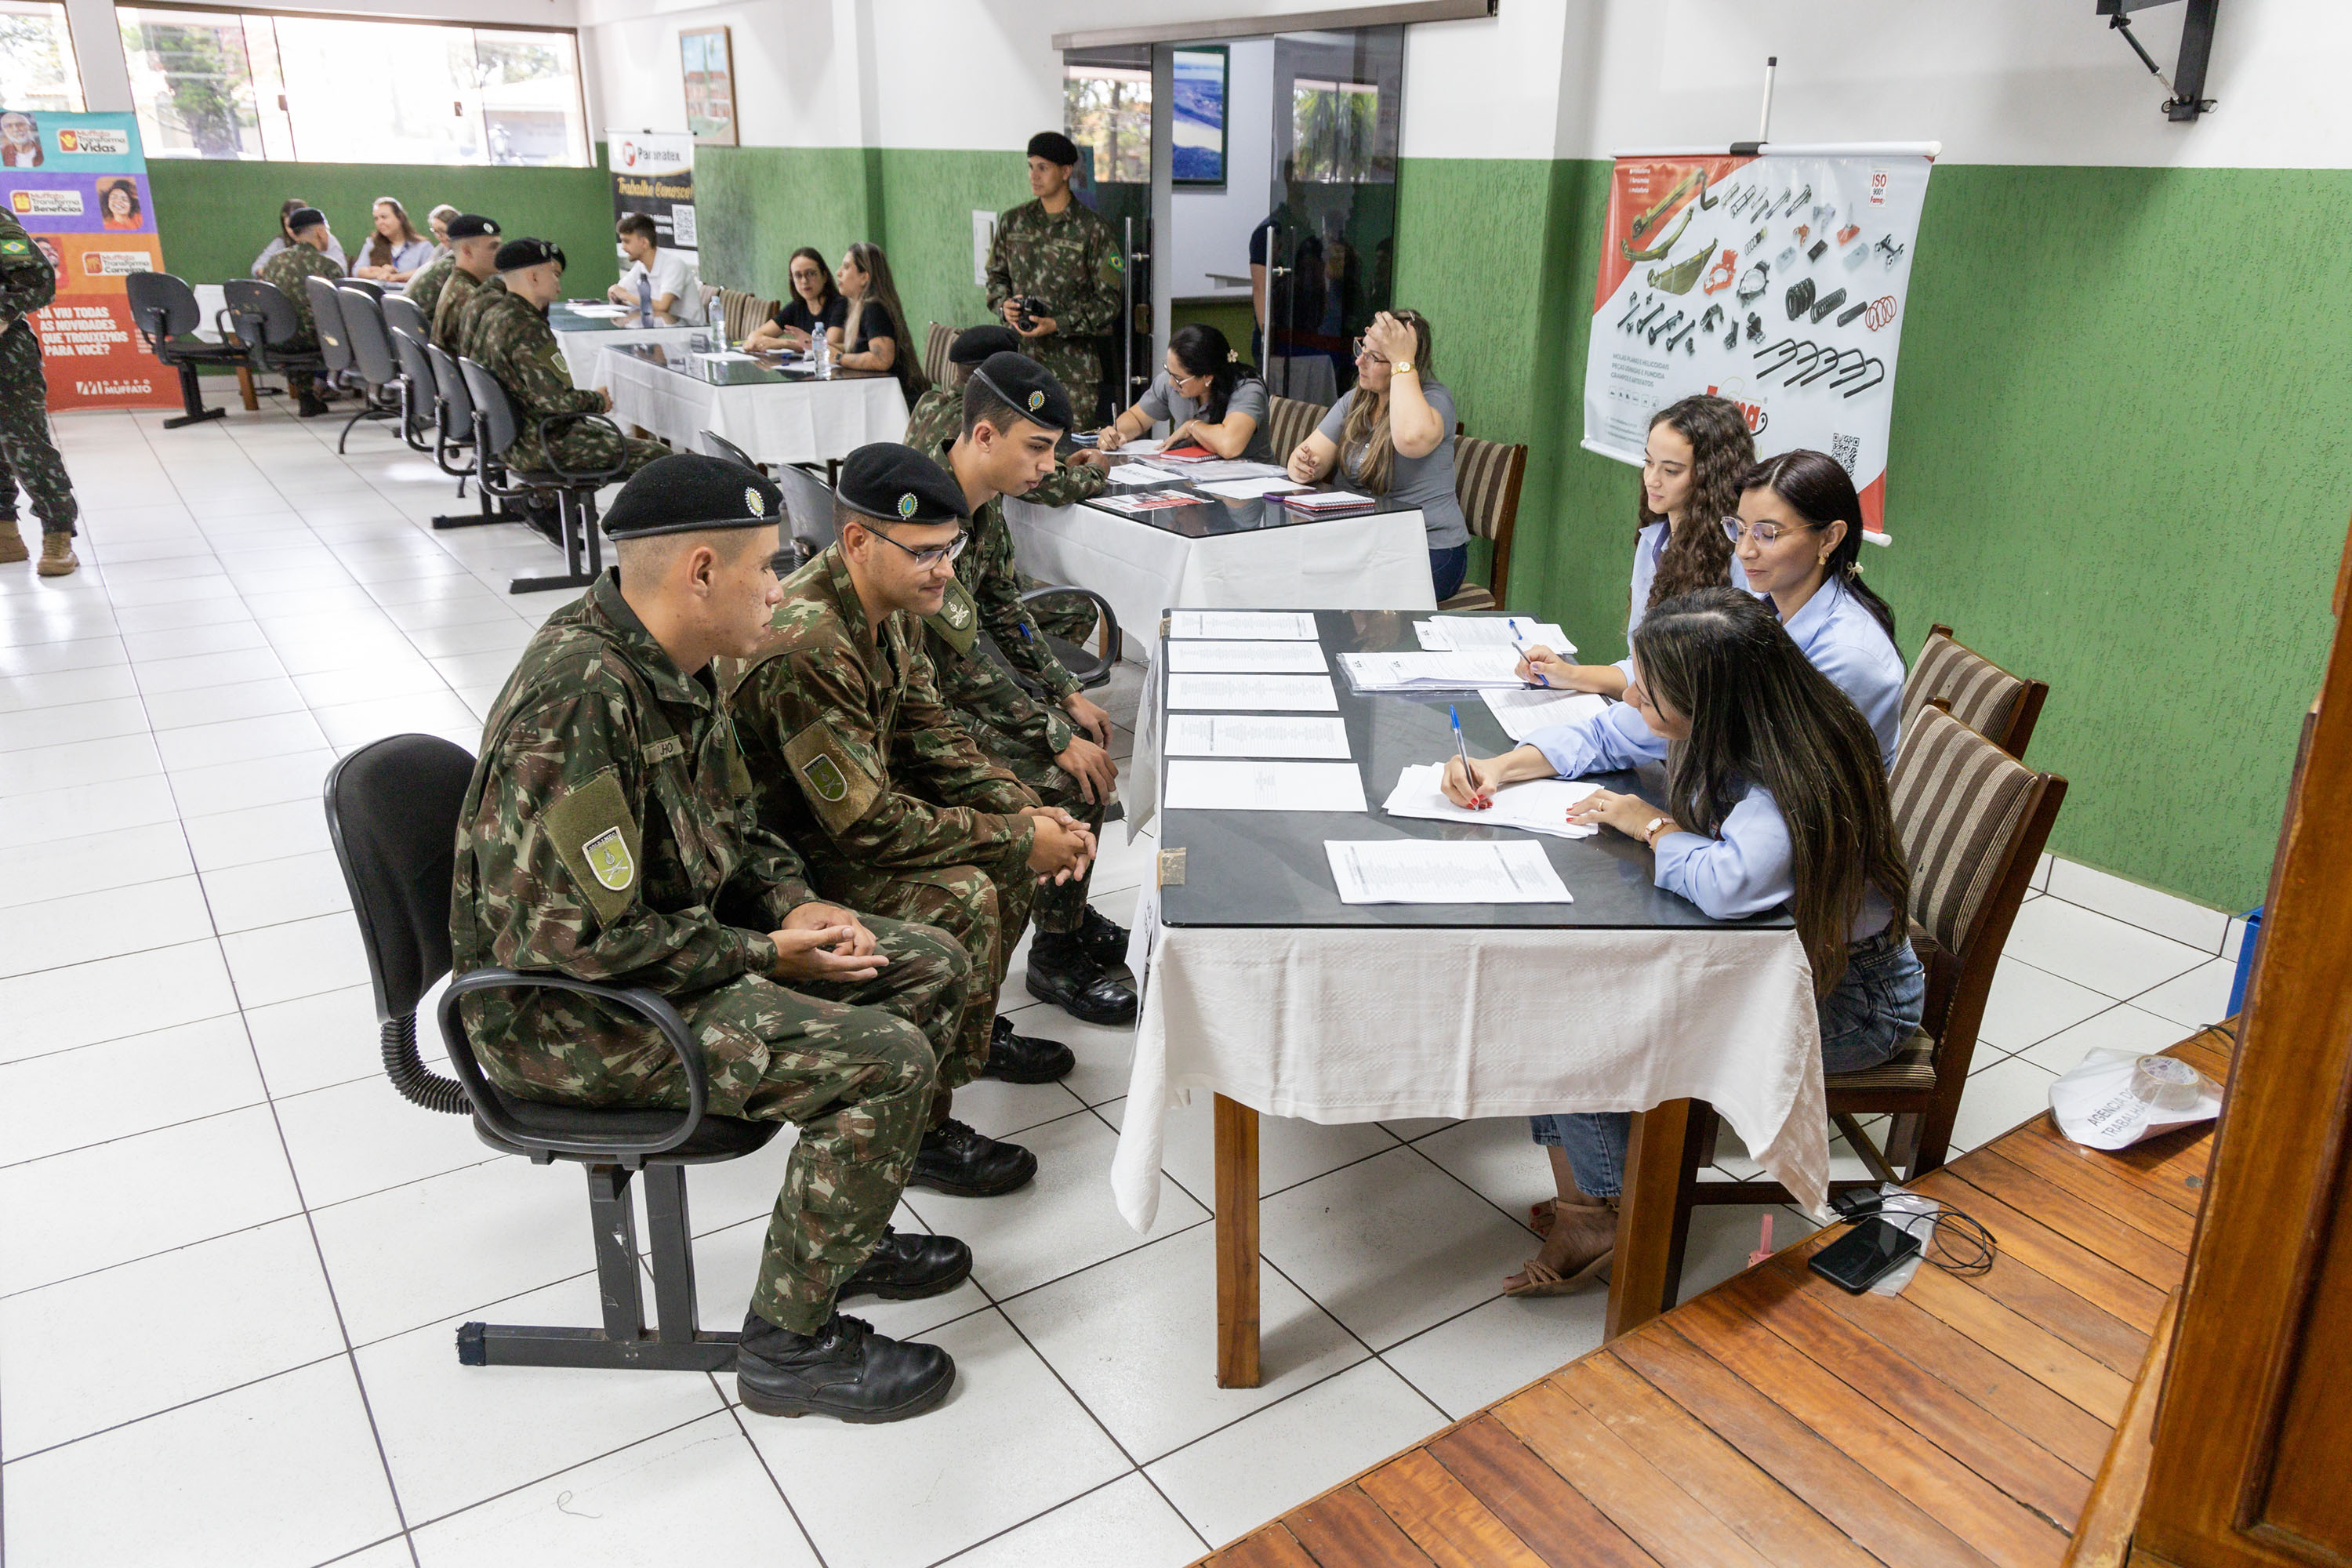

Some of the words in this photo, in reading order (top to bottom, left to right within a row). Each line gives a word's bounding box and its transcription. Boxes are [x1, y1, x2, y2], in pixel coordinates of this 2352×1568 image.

[80, 143, 117, 152] Vidas
[1871, 173, 1887, 187] ISO
[37, 306, 53, 319] JÁ
[53, 307, 73, 318] VIU
[73, 307, 110, 318] TODAS
[40, 320, 55, 332] AS
[55, 319, 117, 331] NOVIDADES
[42, 332, 64, 345] QUE
[64, 332, 129, 343] TROUXEMOS
[44, 345, 75, 356] PARA
[75, 342, 111, 356] VOCÊ?
[104, 385, 152, 394] MUFFATO
[2087, 1098, 2128, 1127] AGÊNCIA
